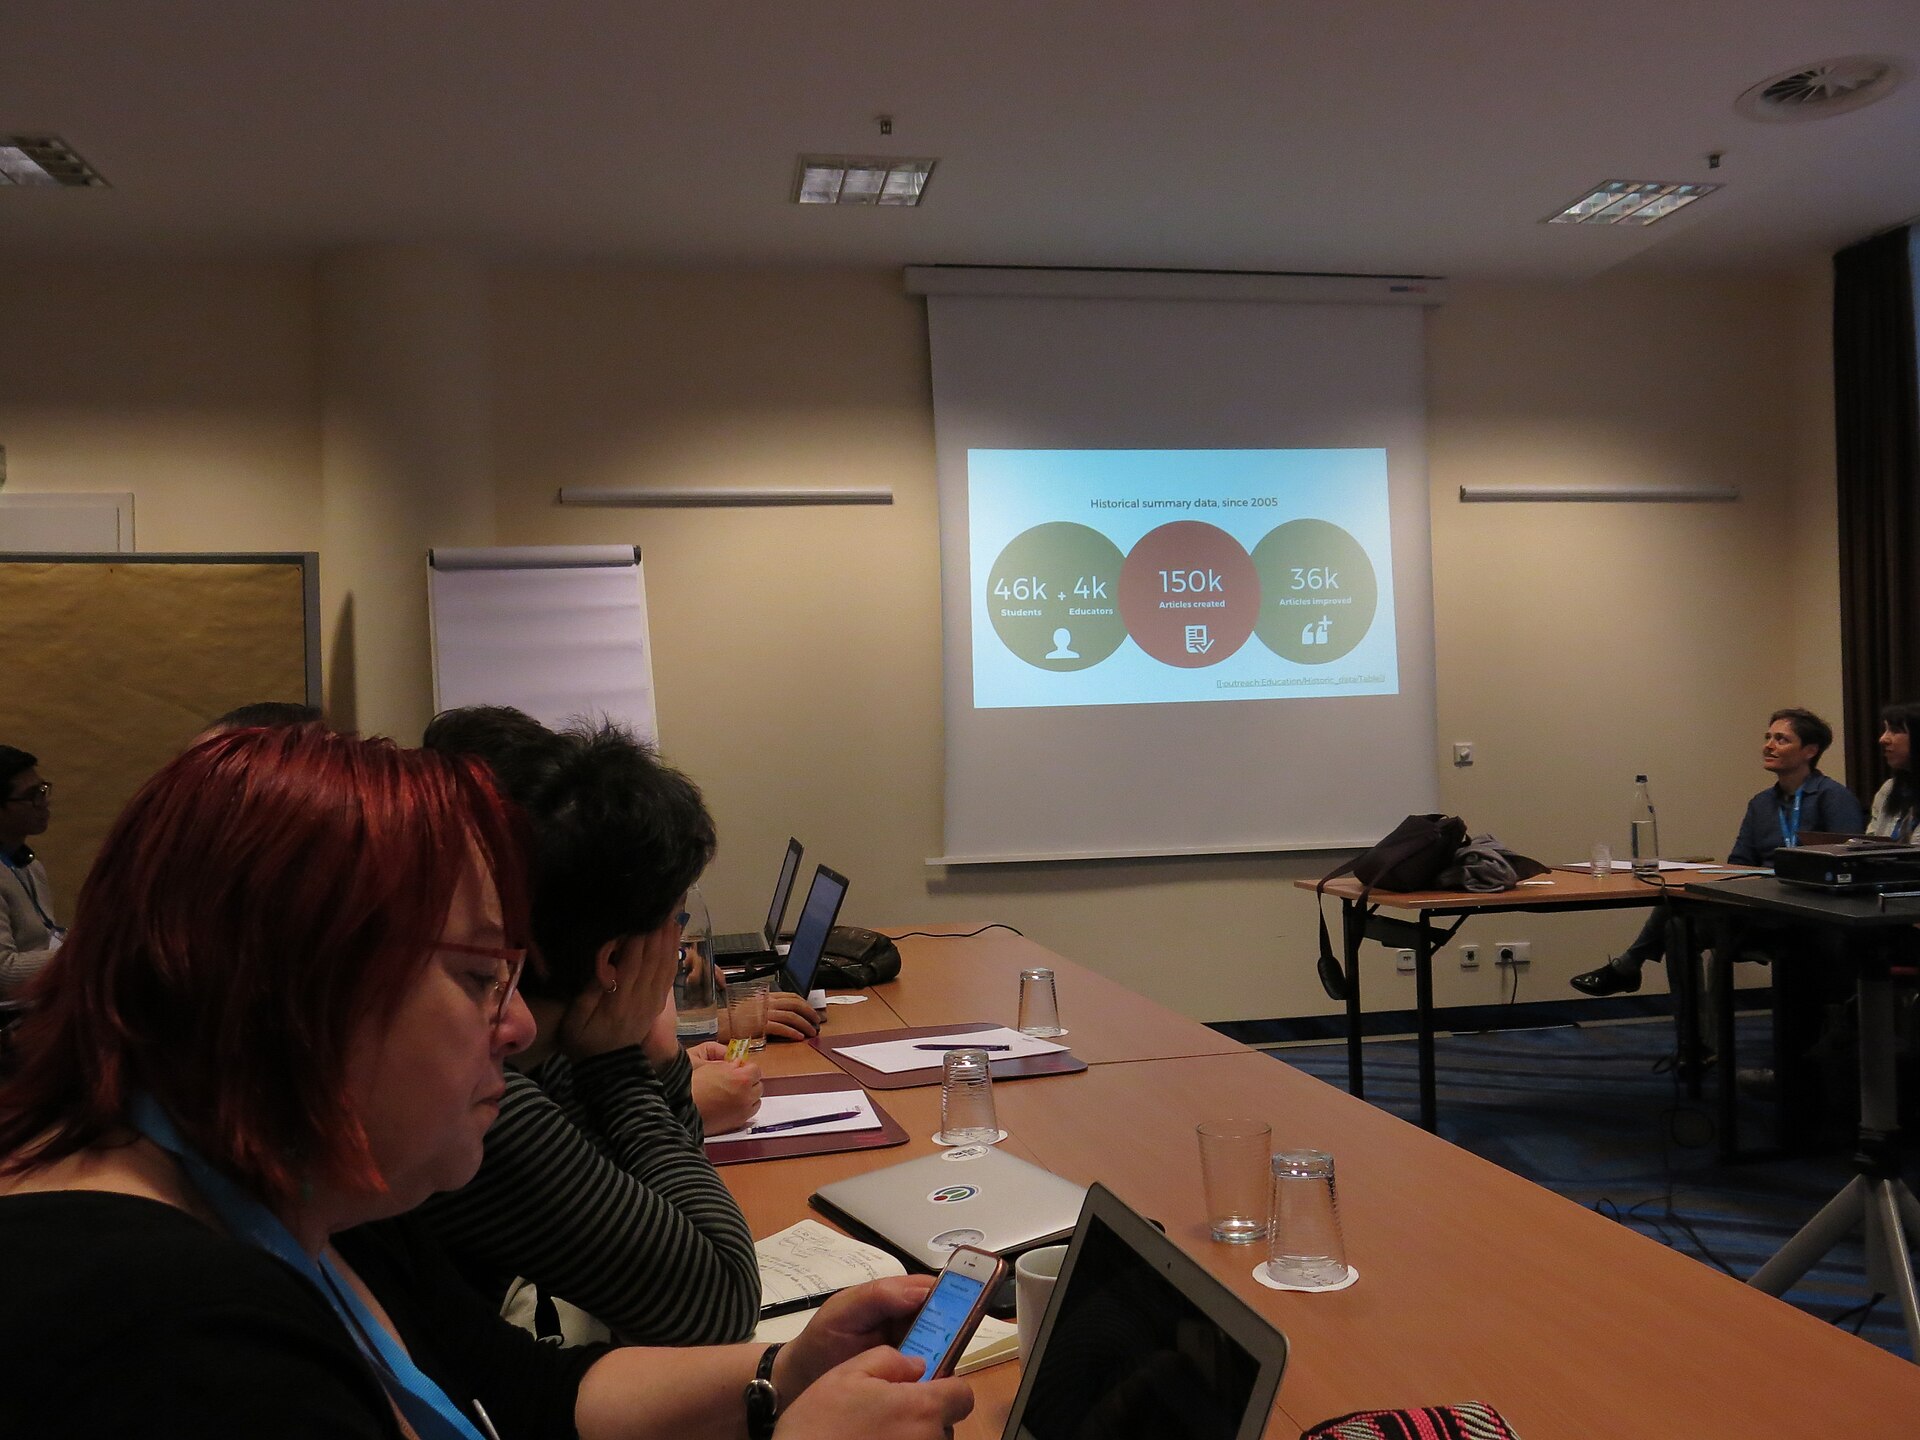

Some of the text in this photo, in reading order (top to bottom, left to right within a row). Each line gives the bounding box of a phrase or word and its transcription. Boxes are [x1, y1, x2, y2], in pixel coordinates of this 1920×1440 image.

[1090, 497, 1278, 510] Historical summary data, since 2005
[1158, 568, 1224, 593] 150k
[1290, 566, 1340, 590] 36k
[993, 576, 1048, 601] 46k
[1073, 575, 1108, 599] 4k
[1159, 599, 1226, 609] Articles created
[1279, 596, 1352, 606] Articles improved
[1000, 608, 1042, 617] Students
[1068, 607, 1114, 616] Educators
